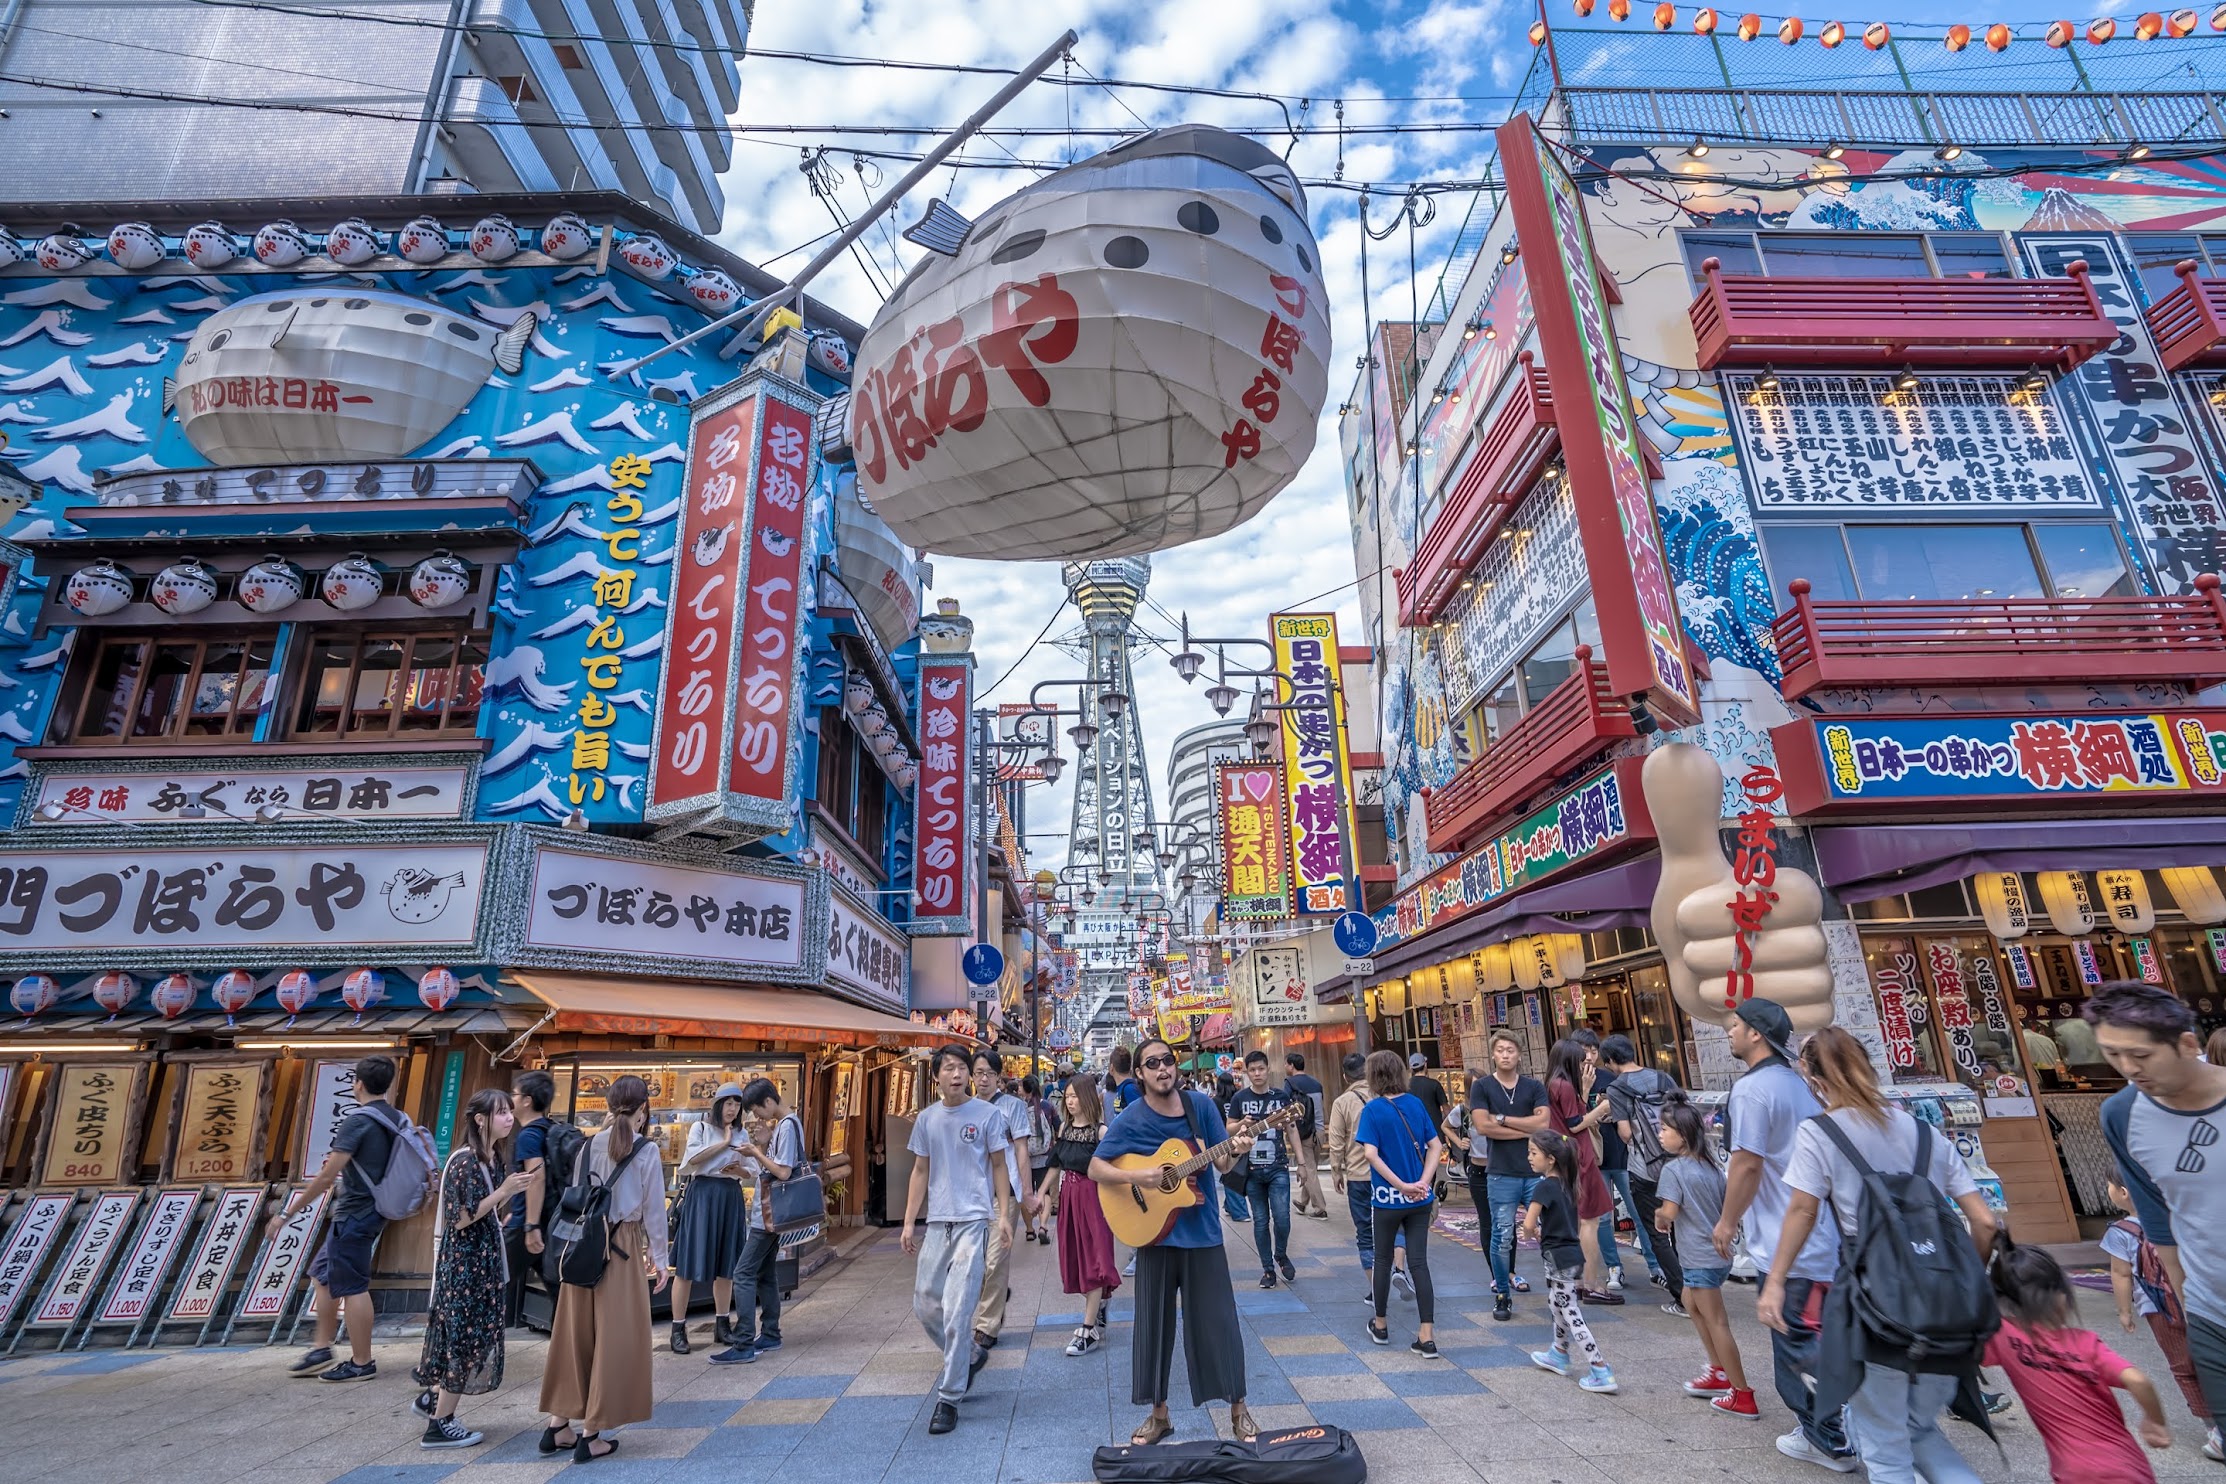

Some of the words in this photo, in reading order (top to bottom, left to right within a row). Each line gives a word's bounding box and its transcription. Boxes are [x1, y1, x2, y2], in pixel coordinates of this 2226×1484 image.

[1553, 187, 1630, 446] 日本一の串かつ
[191, 377, 374, 414] 私の味は日本一
[853, 272, 1079, 484] づぼらや
[1221, 274, 1306, 468] づぼらや
[700, 424, 741, 517] 名物
[761, 421, 805, 514] 名物
[1751, 437, 1785, 502] もち
[1775, 437, 1810, 502] うずら玉子
[1795, 437, 1834, 502] 紅しょうが
[1819, 437, 1854, 502] にんにく
[1842, 437, 1877, 502] 玉ねぎ
[1865, 437, 1901, 502] 山芋
[1888, 437, 1926, 502] しし唐
[1911, 437, 1949, 501] れんこん
[1933, 437, 1971, 501] 銀杏
[1957, 437, 1992, 501] 白ねぎ
[1980, 437, 2017, 501] さつま芋
[2002, 436, 2041, 501] じゃが芋
[2025, 437, 2063, 501] 茄子
[2047, 437, 2087, 501] 椎茸
[2127, 474, 2214, 502] 大阪
[2137, 503, 2222, 527] 新世界
[568, 453, 652, 805] 安うて何んでも旨い
[1277, 619, 1331, 637] 新世界
[1827, 728, 1861, 793] 新世界
[1857, 739, 2016, 777] 日本一の串かつ
[2014, 722, 2139, 787] 横綱
[2126, 722, 2175, 783] 酒処
[2180, 722, 2219, 781] 新世界
[65, 786, 130, 814] 珍味
[1510, 825, 1562, 874] 日本一の串かつ
[1558, 784, 1610, 858] 横綱
[1602, 774, 1626, 837] 酒処
[1228, 805, 1266, 896] 通天閣
[1262, 804, 1281, 894] TSUTENKAKU
[1460, 851, 1493, 906] 横綱
[55, 862, 366, 934] づぼらや
[547, 882, 792, 942] づぼらや本店
[1249, 898, 1281, 913] 横綱
[2001, 875, 2026, 928] 自慢の逸品
[2111, 885, 2140, 921] 寿司
[829, 908, 902, 996] ふぐ料理専門
[1894, 952, 1927, 1022] ソースの
[73, 1072, 115, 1156] ふぐ皮ちり
[197, 1072, 242, 1154] ふぐ天ぷら
[441, 1126, 448, 1137] 5
[64, 1163, 103, 1178] 840
[188, 1159, 234, 1175] 1,200
[63, 1202, 123, 1295] ふぐうどん定食
[127, 1200, 186, 1293] にぎりずし定食
[195, 1198, 249, 1291] 天丼定食
[48, 1302, 74, 1316] 1,150
[113, 1300, 141, 1314] 1,000
[182, 1298, 209, 1312] 1,000
[252, 1296, 278, 1310] 1,500
